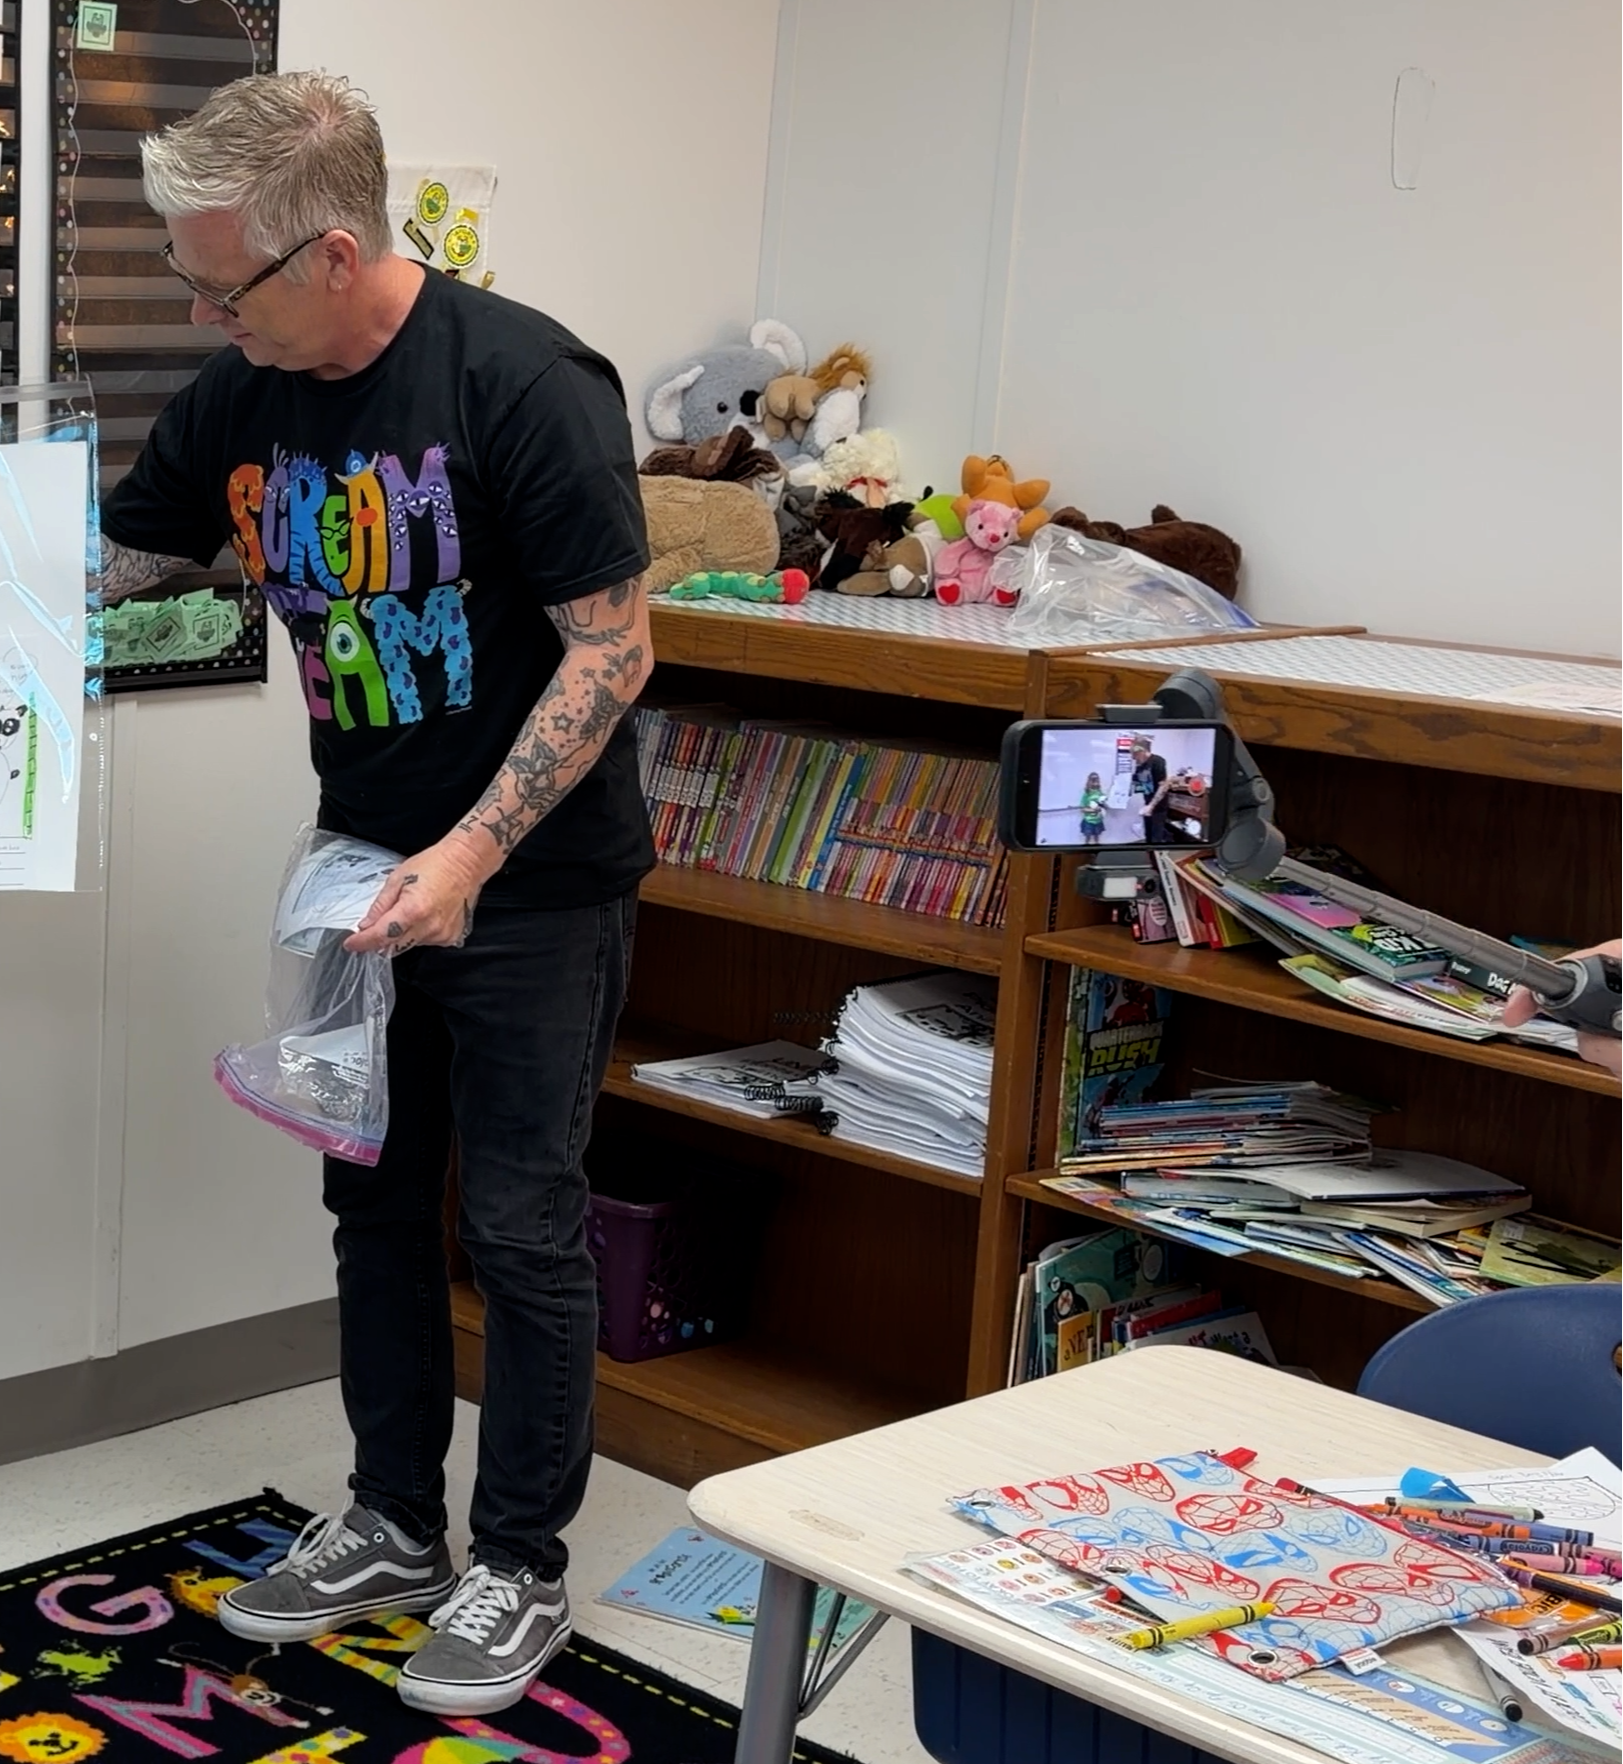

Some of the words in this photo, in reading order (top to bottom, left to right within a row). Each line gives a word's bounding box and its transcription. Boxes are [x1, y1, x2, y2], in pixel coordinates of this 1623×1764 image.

[227, 442, 461, 598] SCREAM
[1504, 1542, 1551, 1555] Crayola
[1531, 1592, 1569, 1614] BIC
